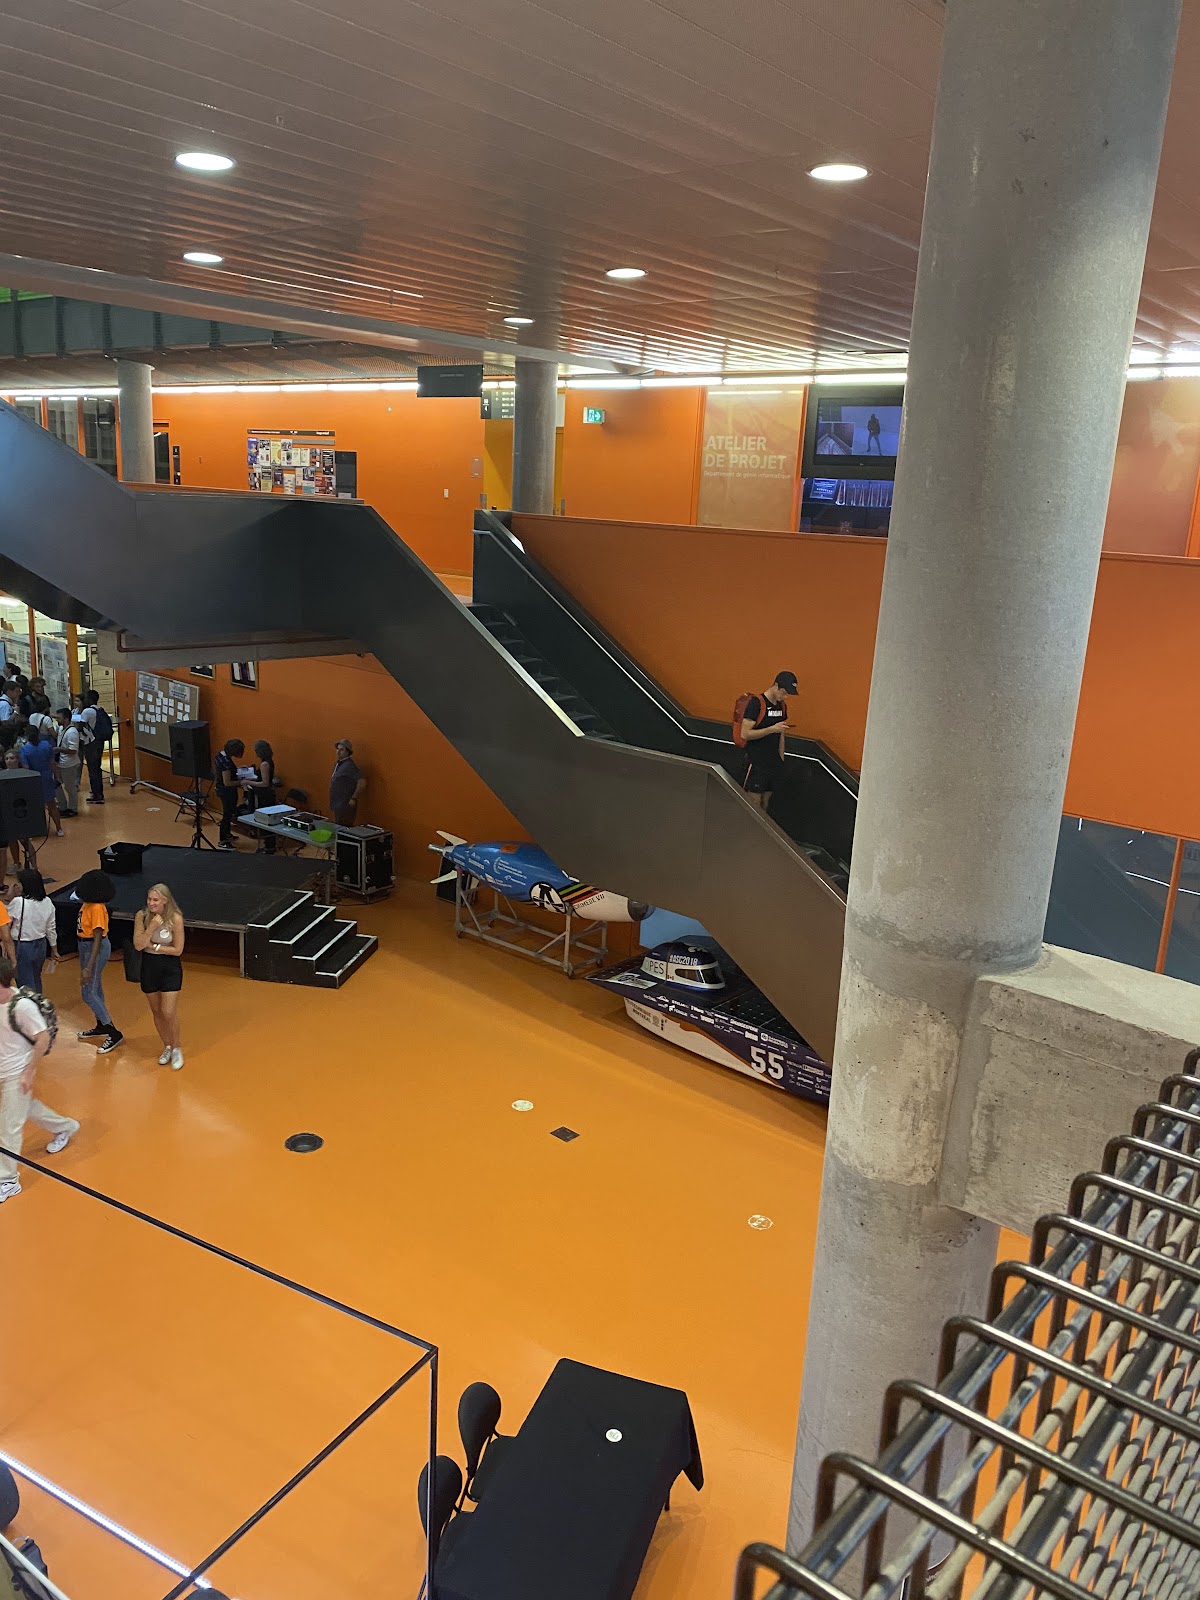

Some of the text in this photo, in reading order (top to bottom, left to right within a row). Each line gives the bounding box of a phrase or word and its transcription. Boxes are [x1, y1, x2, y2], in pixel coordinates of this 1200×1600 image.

[705, 435, 767, 451] ATELIER
[704, 453, 787, 470] DE PROJET
[750, 1045, 784, 1080] 55
